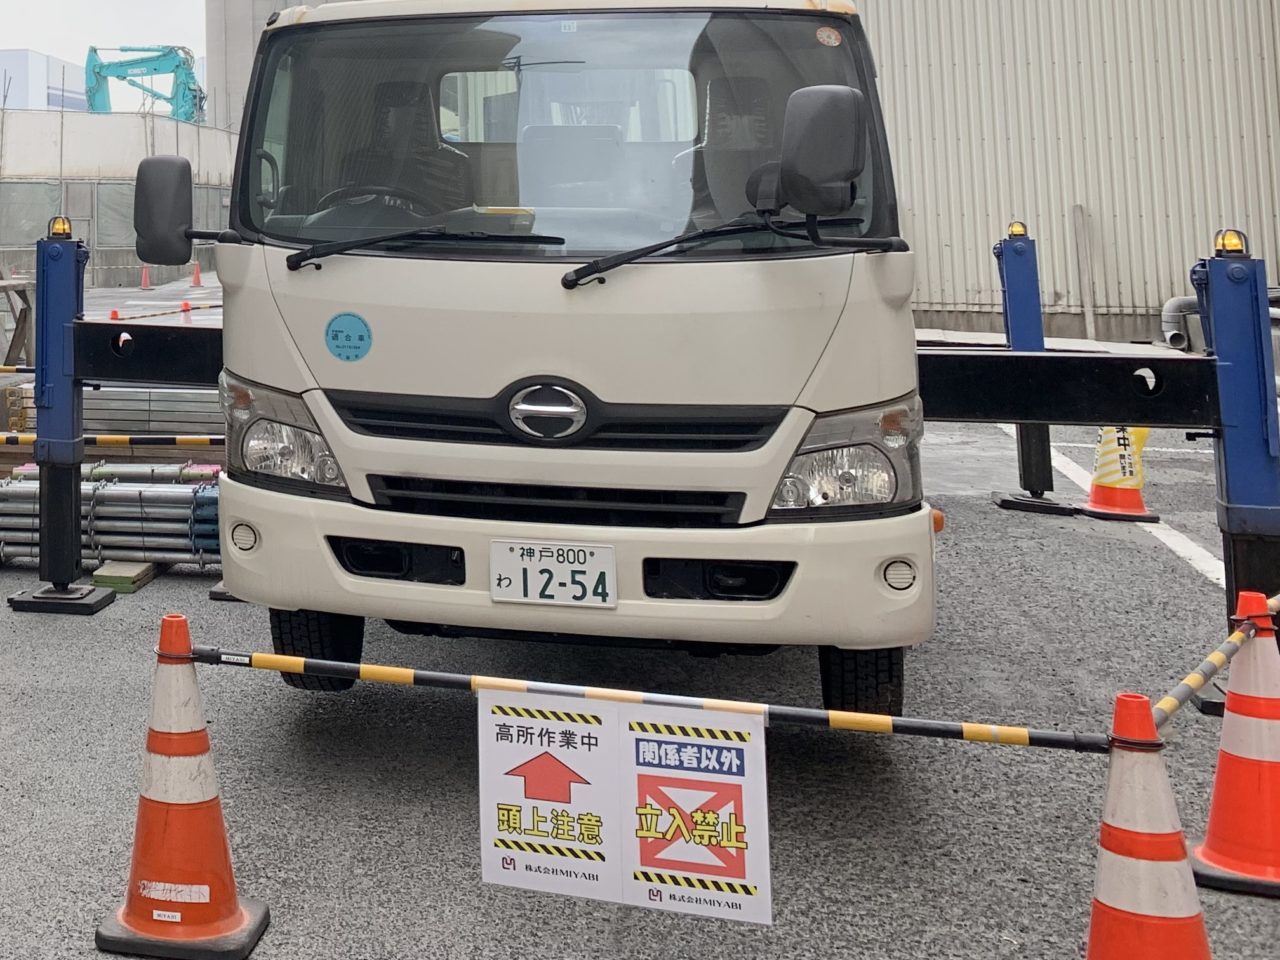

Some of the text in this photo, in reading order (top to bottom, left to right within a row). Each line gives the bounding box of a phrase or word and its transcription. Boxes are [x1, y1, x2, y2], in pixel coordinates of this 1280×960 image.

[496, 567, 609, 603] わ 12-54
[494, 723, 599, 752] 高所作業中
[638, 740, 742, 773] 関係者以外
[496, 802, 603, 845] 頭上注意
[635, 803, 748, 850] 立入禁止
[525, 863, 599, 882] 株式会社MIYABI
[668, 892, 743, 911] 株式会社MIYABI
